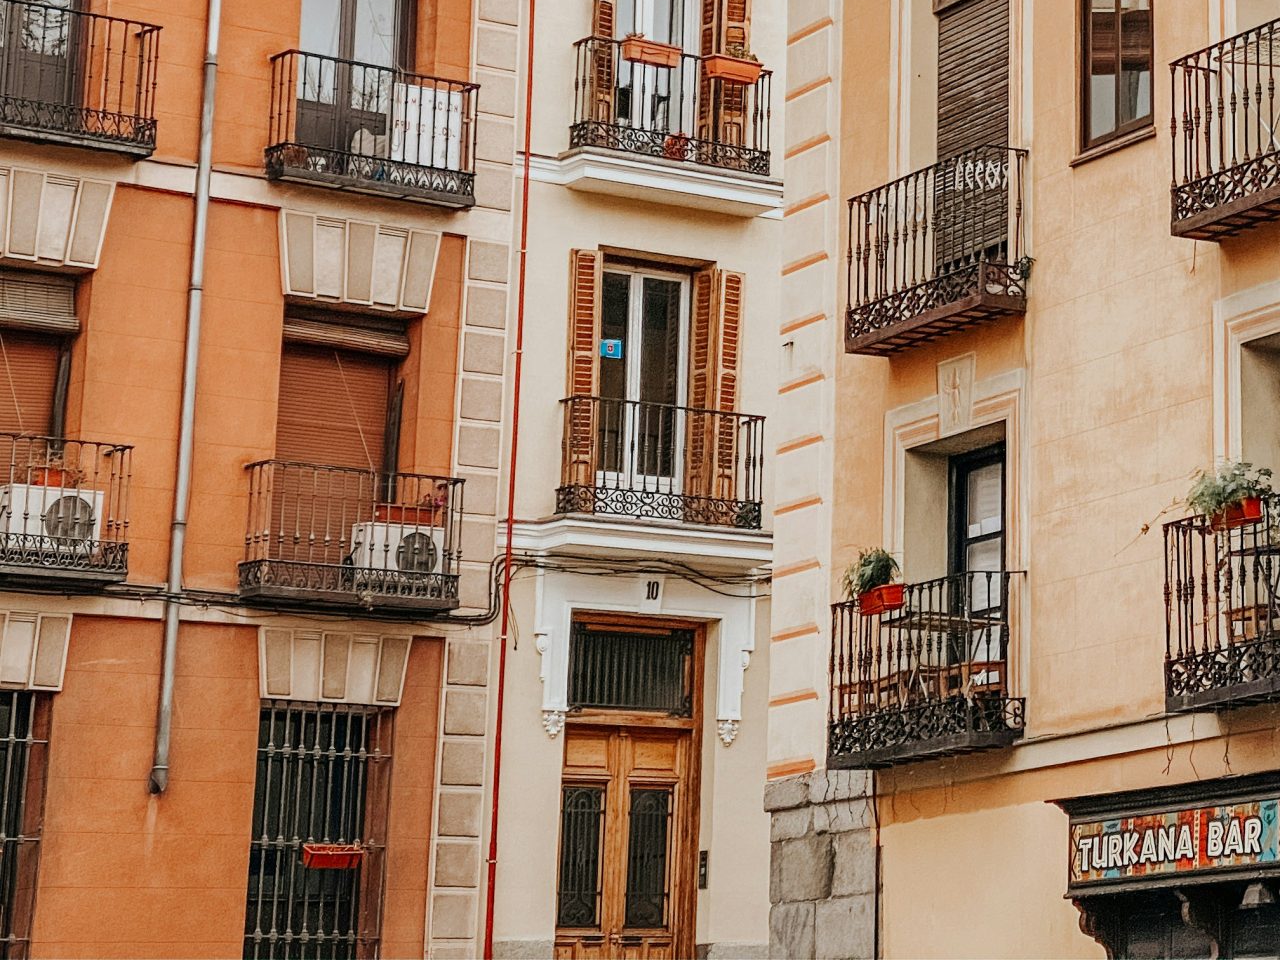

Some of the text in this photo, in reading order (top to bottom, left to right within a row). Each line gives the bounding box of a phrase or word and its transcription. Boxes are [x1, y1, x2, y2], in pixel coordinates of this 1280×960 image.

[646, 581, 660, 600] 10
[1078, 817, 1262, 871] TURKANA BAR
